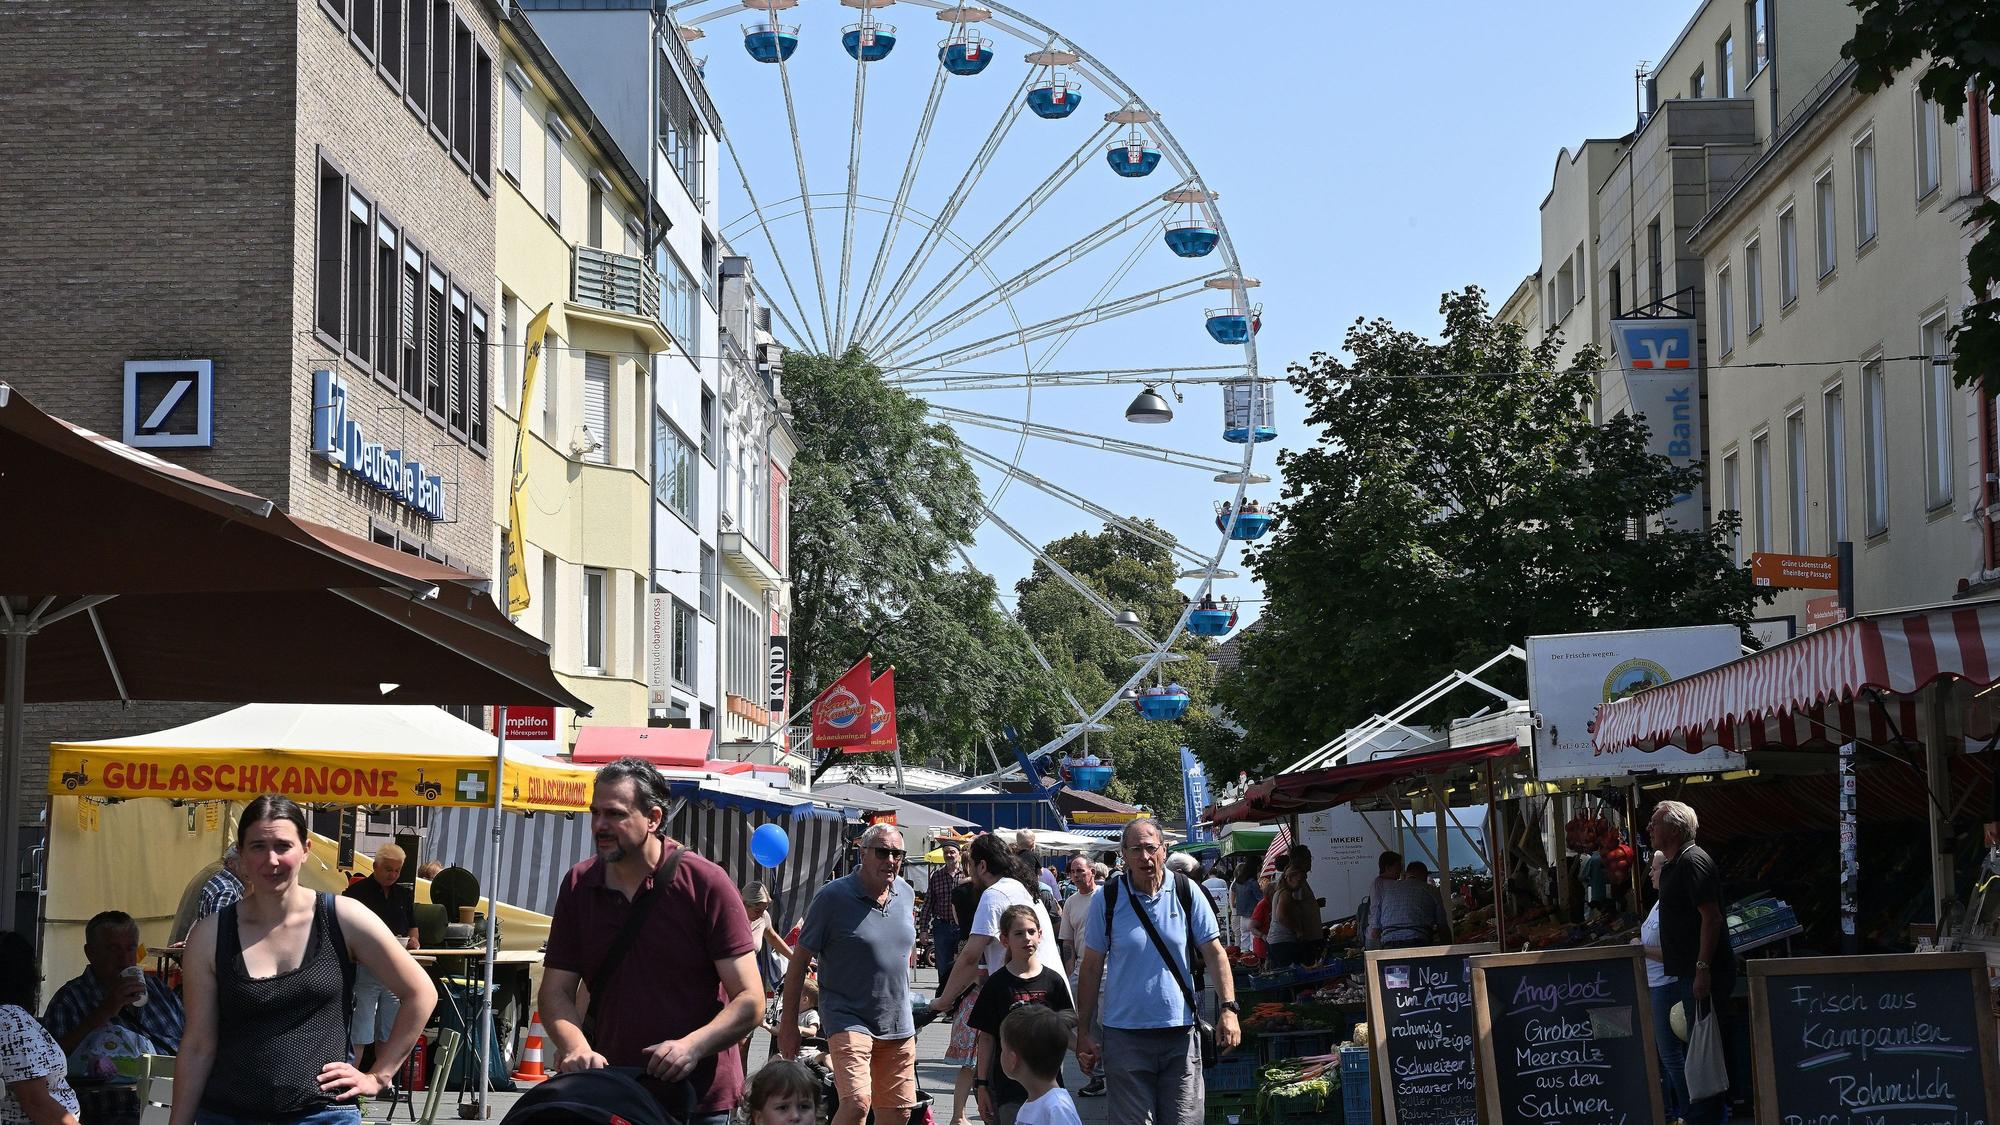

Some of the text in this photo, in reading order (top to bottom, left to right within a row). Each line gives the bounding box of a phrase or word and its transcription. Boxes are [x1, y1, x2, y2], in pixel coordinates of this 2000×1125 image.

[1665, 386, 1690, 456] Bank
[354, 420, 446, 520] Deutsche Bank
[1798, 560, 1832, 570] Ladenstraße
[1810, 570, 1832, 580] Passage
[652, 598, 660, 686] lernstudiobarbarossa
[770, 646, 784, 696] KIND
[507, 716, 548, 728] mplifon
[102, 762, 398, 798] GULASCHKANONE
[527, 776, 586, 806] GULASCHKANONE
[1419, 966, 1448, 986] Neu
[1396, 992, 1420, 1008] im
[1512, 972, 1612, 1012] Angebot
[1790, 984, 1918, 1014] Frisch aus
[1524, 1016, 1594, 1042] Grobes
[1802, 1018, 1951, 1061] Kampanien
[1394, 1056, 1465, 1076] Schweizer
[1516, 1040, 1604, 1067] Meersalz
[1398, 1083, 1453, 1094] Schwarzer
[1536, 1069, 1604, 1088] aus den
[1828, 1066, 1956, 1107] Rohmilch
[1518, 1094, 1614, 1118] Salinen
